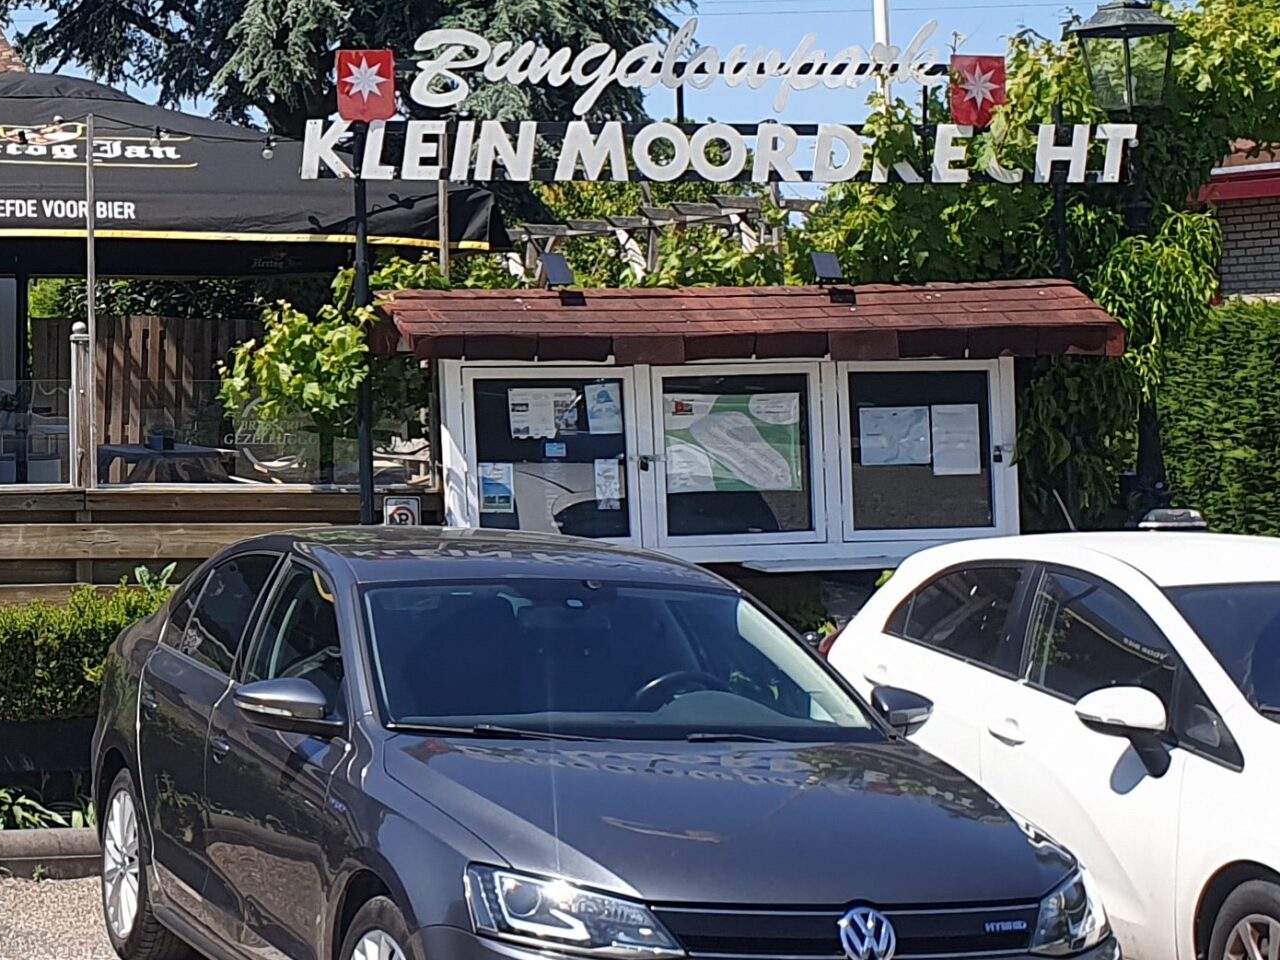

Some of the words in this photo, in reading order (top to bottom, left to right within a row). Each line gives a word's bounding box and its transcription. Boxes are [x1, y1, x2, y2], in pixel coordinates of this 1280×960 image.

[85, 139, 182, 162] Jan
[300, 118, 537, 181] KLEIN
[41, 199, 88, 219] VOOR
[95, 200, 136, 220] BIER
